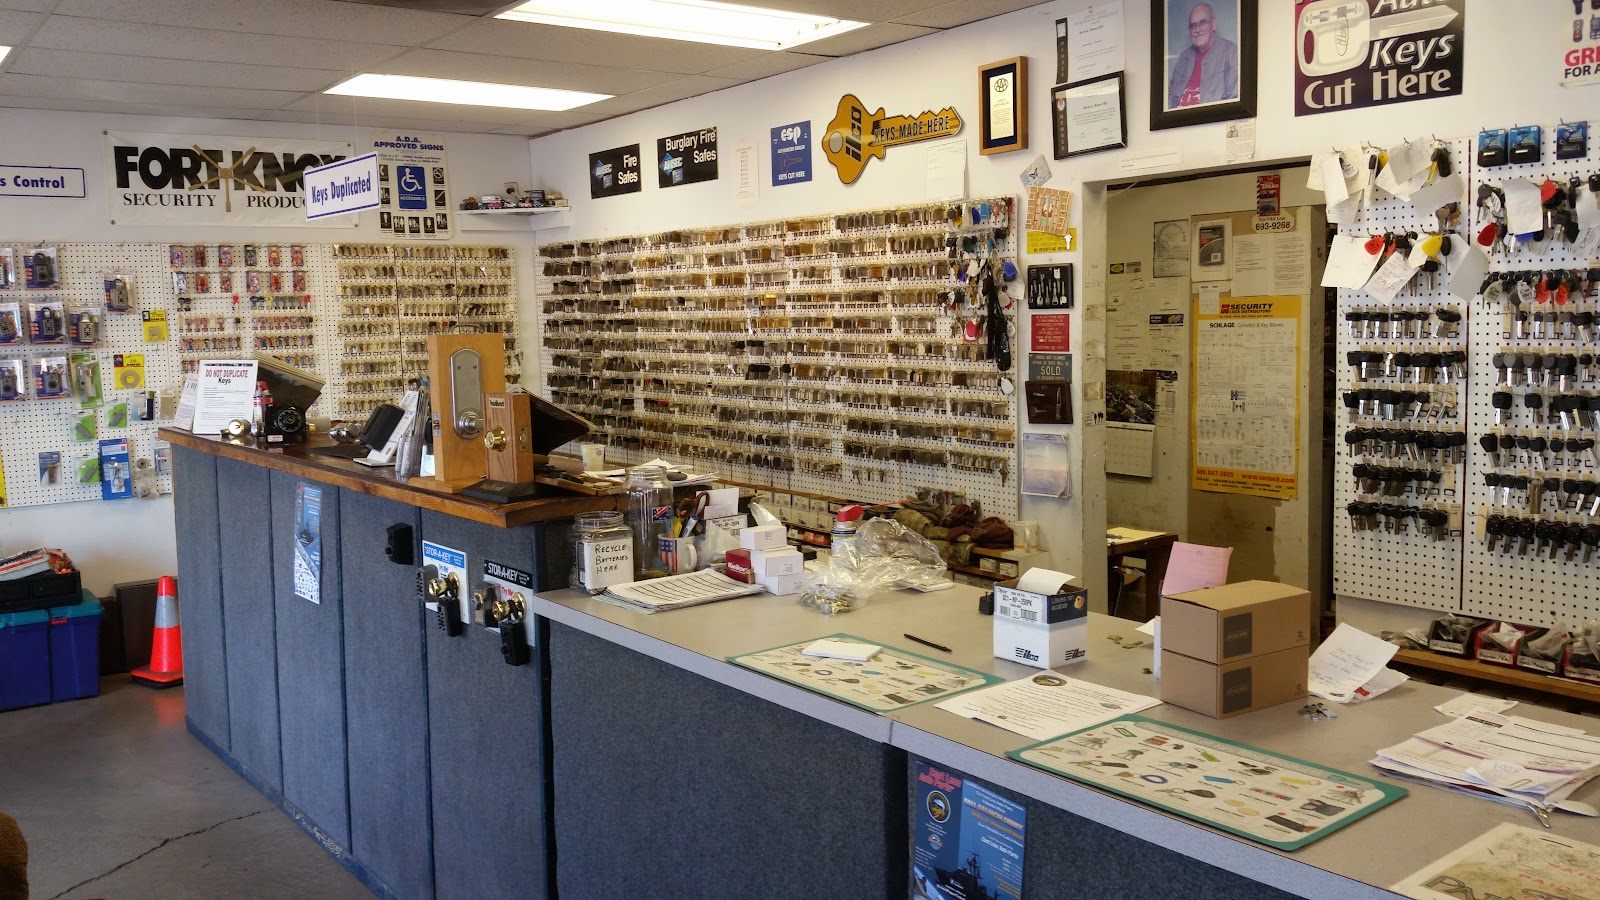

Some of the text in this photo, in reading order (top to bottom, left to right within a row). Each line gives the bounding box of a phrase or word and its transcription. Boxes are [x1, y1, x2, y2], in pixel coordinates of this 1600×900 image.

[1369, 34, 1455, 72] Keys
[1564, 65, 1592, 79] FOR
[1303, 68, 1452, 109] Cut Here
[873, 115, 950, 144] KEYS MADE HERE
[374, 141, 444, 151] APPROVED SIGNS
[665, 130, 716, 152] Burglary Fire
[623, 154, 638, 169] Fire
[693, 149, 717, 164] Safes
[113, 145, 347, 193] FORT KNO
[795, 170, 806, 178] HERE
[13, 174, 65, 190] Control
[617, 169, 639, 185] Safes
[311, 170, 372, 206] Keys Duplicated
[123, 193, 306, 209] SECURITY PRODU
[205, 369, 249, 378] DO NOT DUPLICATE
[1040, 365, 1061, 376] SOLD
[218, 377, 231, 385] Keys
[426, 547, 451, 561] STOR-A-KEY
[594, 543, 628, 555] RECYCLE
[595, 555, 629, 567] BATTERIES
[487, 562, 519, 582] STOR-A-KEY
[596, 564, 619, 575] HERE
[1023, 649, 1040, 662] ilco
